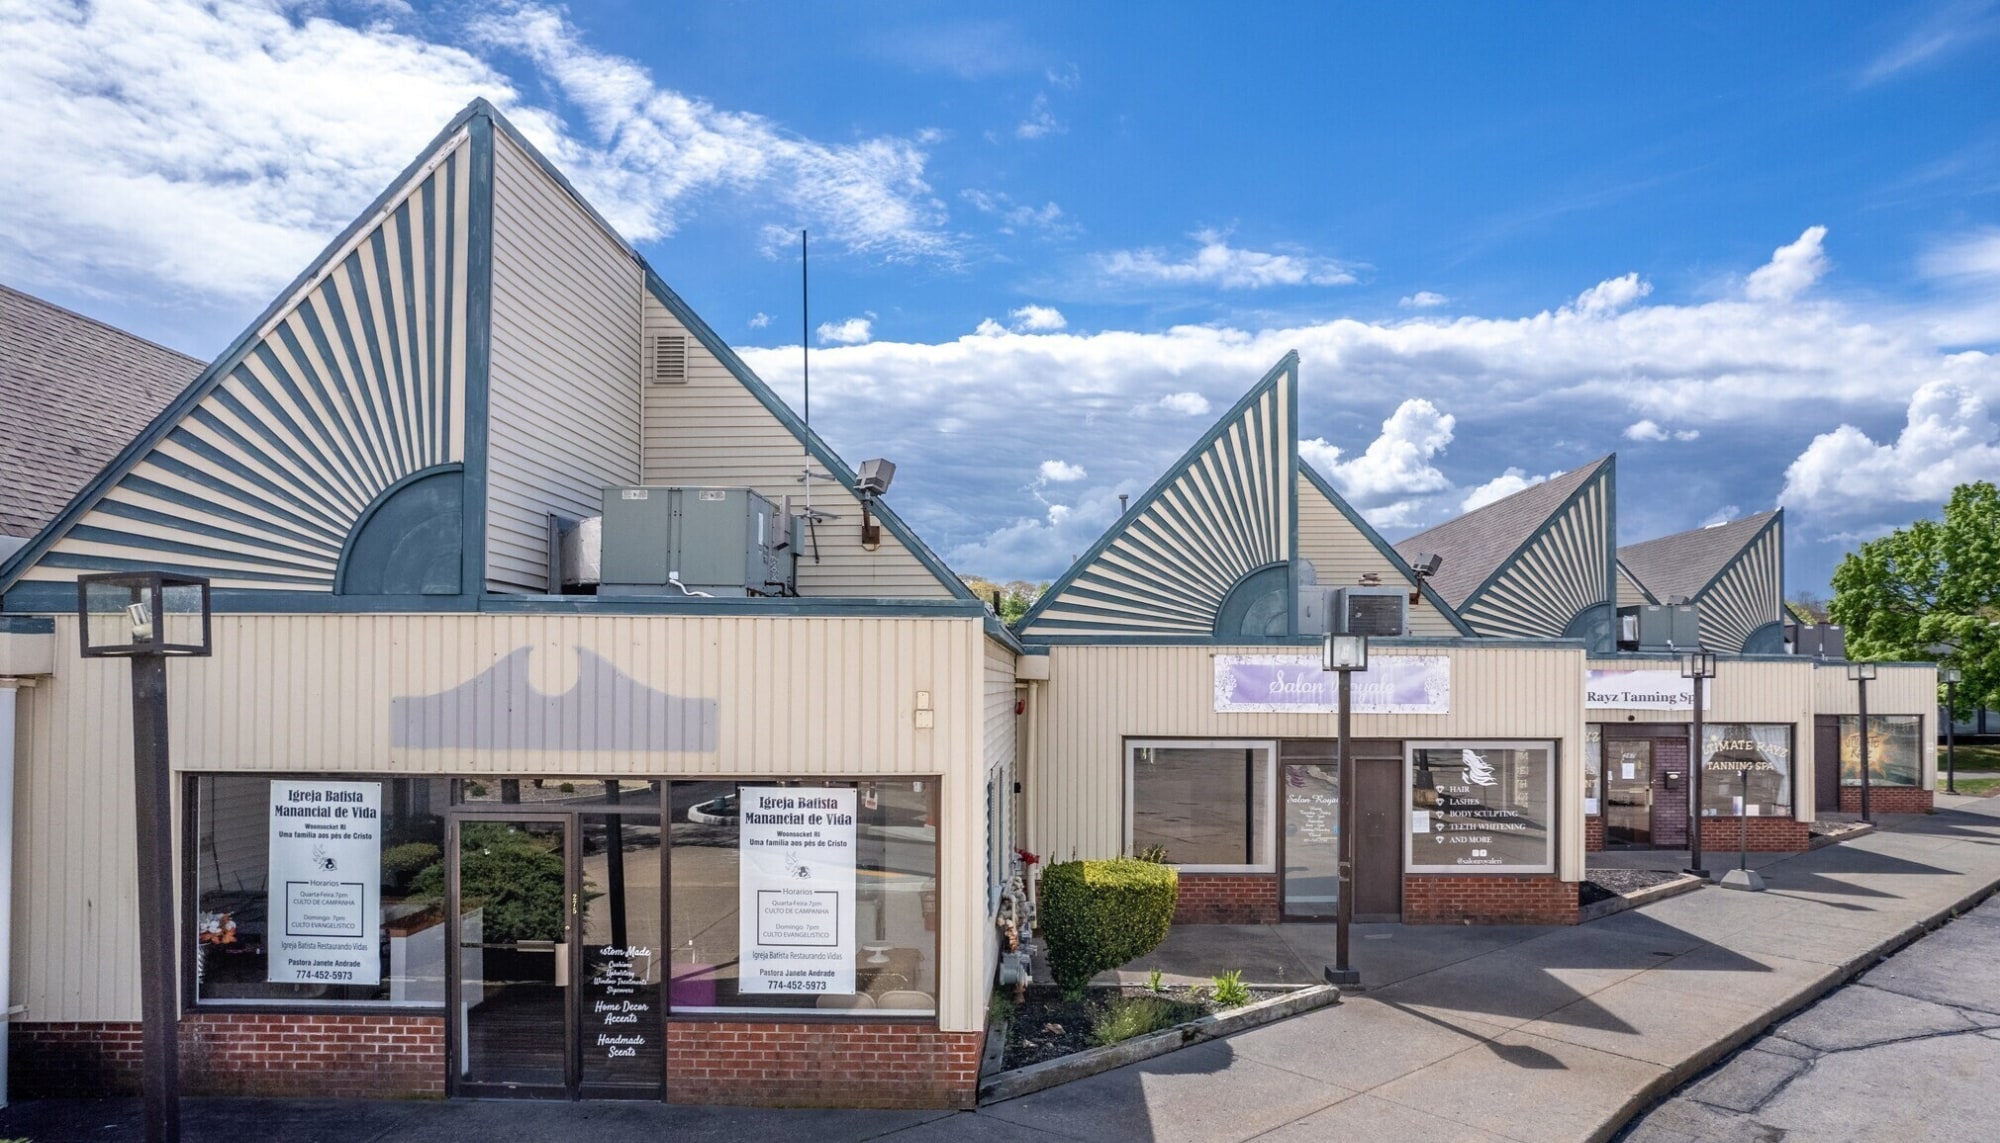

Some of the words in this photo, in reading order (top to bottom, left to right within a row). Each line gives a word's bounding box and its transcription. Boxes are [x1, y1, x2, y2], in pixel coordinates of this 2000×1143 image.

[1270, 670, 1324, 694] Salon
[1587, 692, 1618, 704] Rayz
[1621, 692, 1677, 704] Tanning
[1680, 692, 1694, 704] Sp
[1756, 742, 1788, 758] RAYZ
[1707, 762, 1752, 770] TANNING
[1755, 762, 1775, 770] SPA
[288, 790, 322, 802] Igreja
[325, 790, 363, 802] Batista
[1287, 794, 1310, 803] Salon
[759, 796, 794, 810] Igreja
[798, 797, 838, 809] Batista
[274, 805, 330, 818] Manancial
[334, 806, 348, 818] de
[352, 806, 376, 818] Vida
[745, 812, 804, 825] Manancial
[808, 814, 822, 825] de
[826, 813, 852, 825] Vida
[282, 941, 296, 950] Igreja
[317, 942, 352, 950] Restaurando
[625, 946, 651, 957] Made
[753, 951, 768, 960] Igreja
[296, 970, 352, 980] 774-452-5973
[768, 980, 826, 990] 774-452-5973
[595, 1000, 621, 1013] Home
[622, 1000, 649, 1012] Decor
[604, 1013, 637, 1024] Accents
[597, 1034, 645, 1045] Handmade
[608, 1046, 636, 1058] Scents
